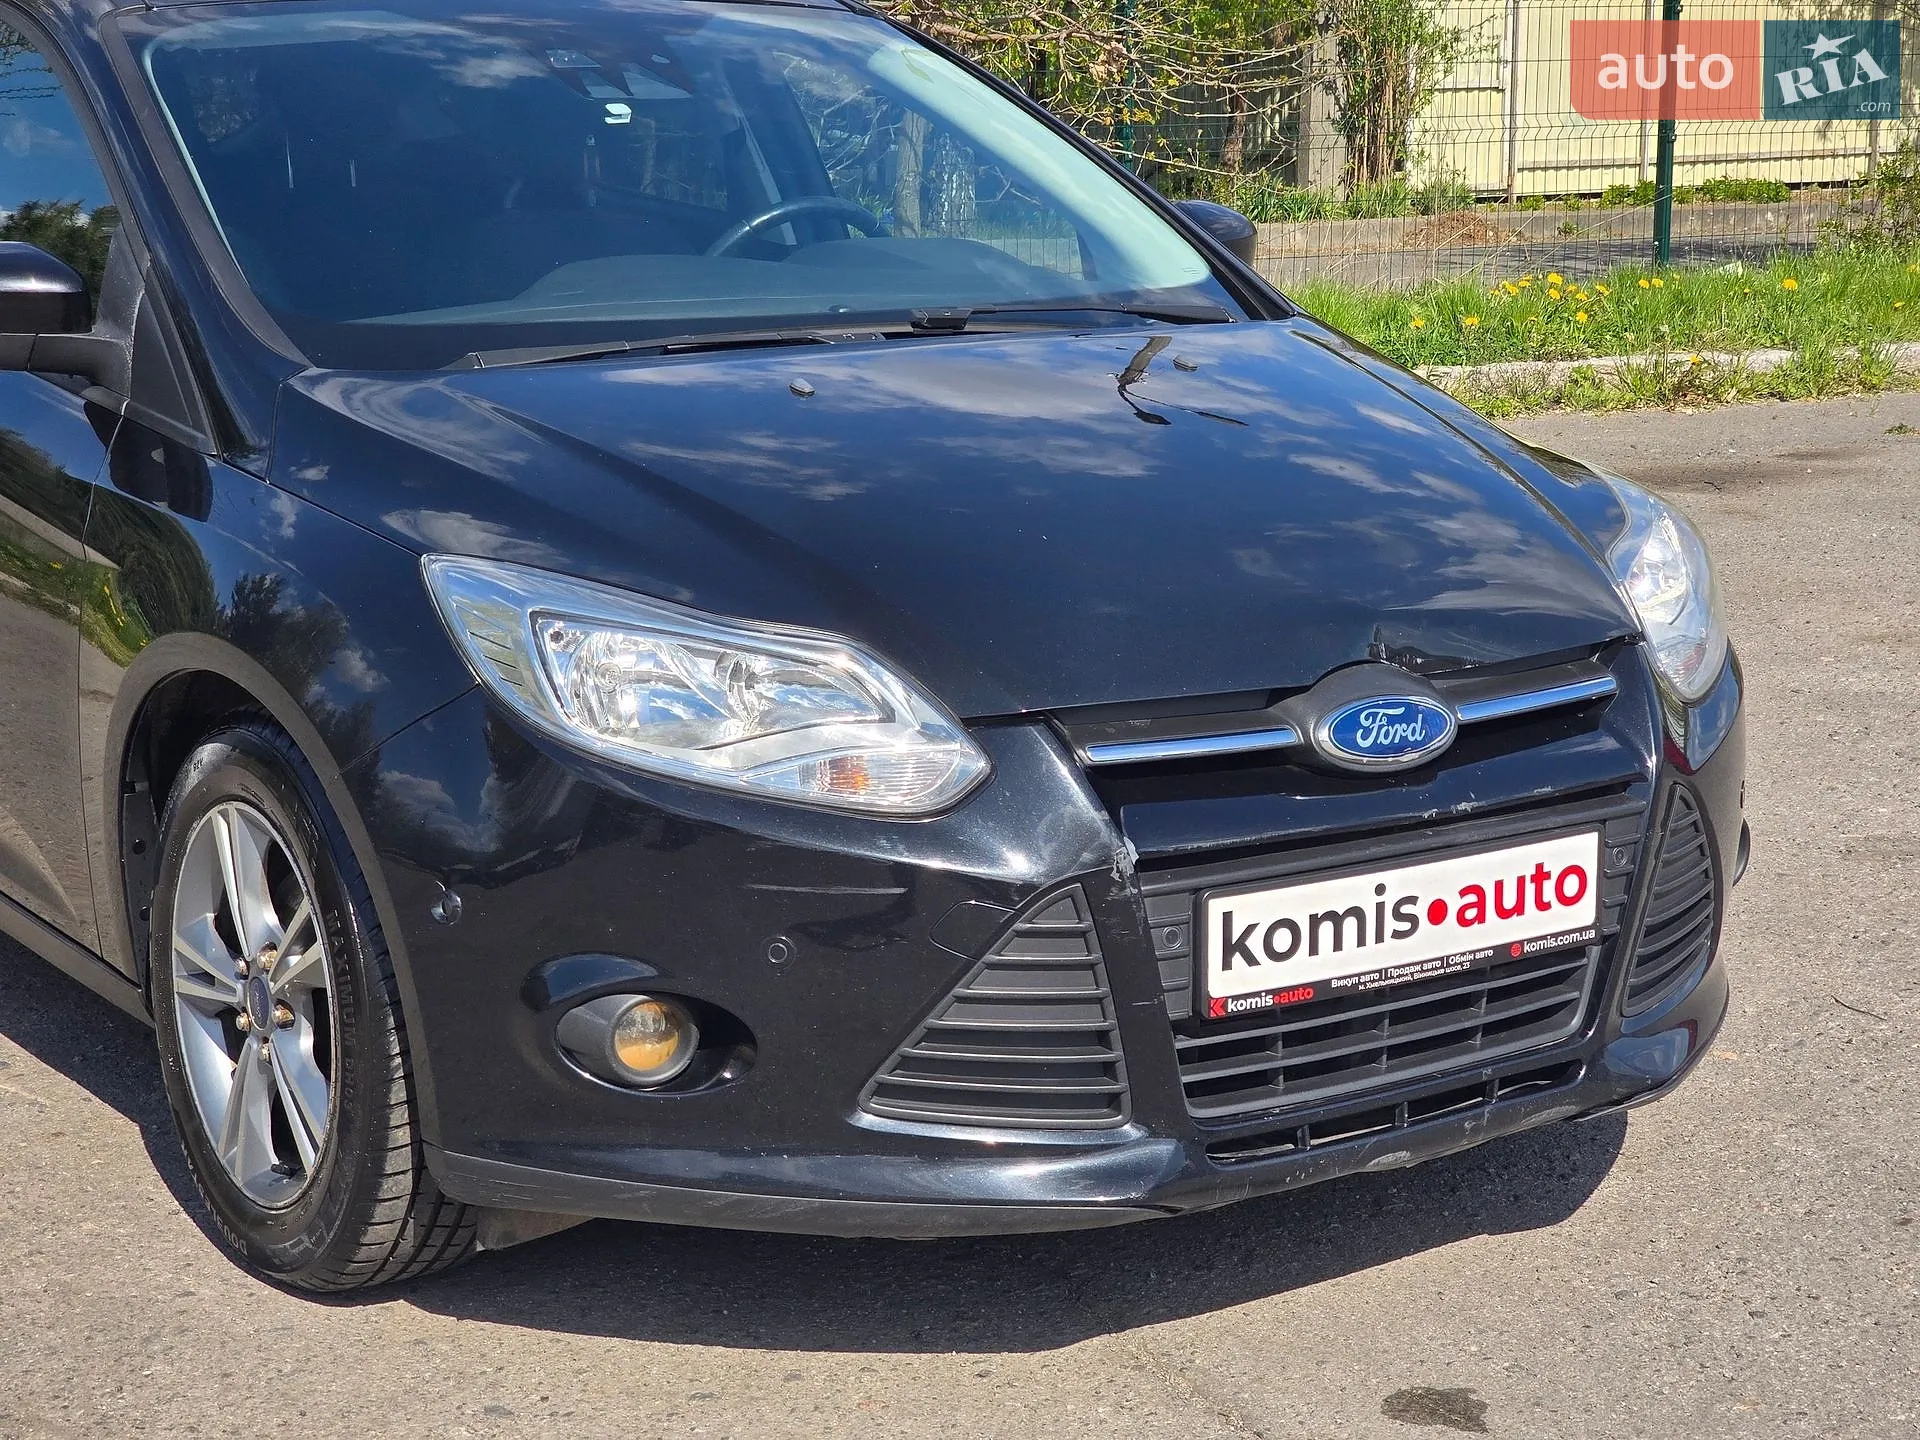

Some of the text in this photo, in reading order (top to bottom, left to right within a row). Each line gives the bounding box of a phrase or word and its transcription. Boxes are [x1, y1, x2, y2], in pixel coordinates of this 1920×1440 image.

[1356, 706, 1425, 748] Ford
[1523, 929, 1596, 953] komis.com.ua
[1331, 976, 1359, 988] Викуп
[1359, 972, 1380, 983] авто
[1387, 963, 1422, 978] Продаж
[1422, 960, 1441, 970] авто
[1448, 951, 1474, 964] Обмін
[1475, 949, 1494, 959] авто
